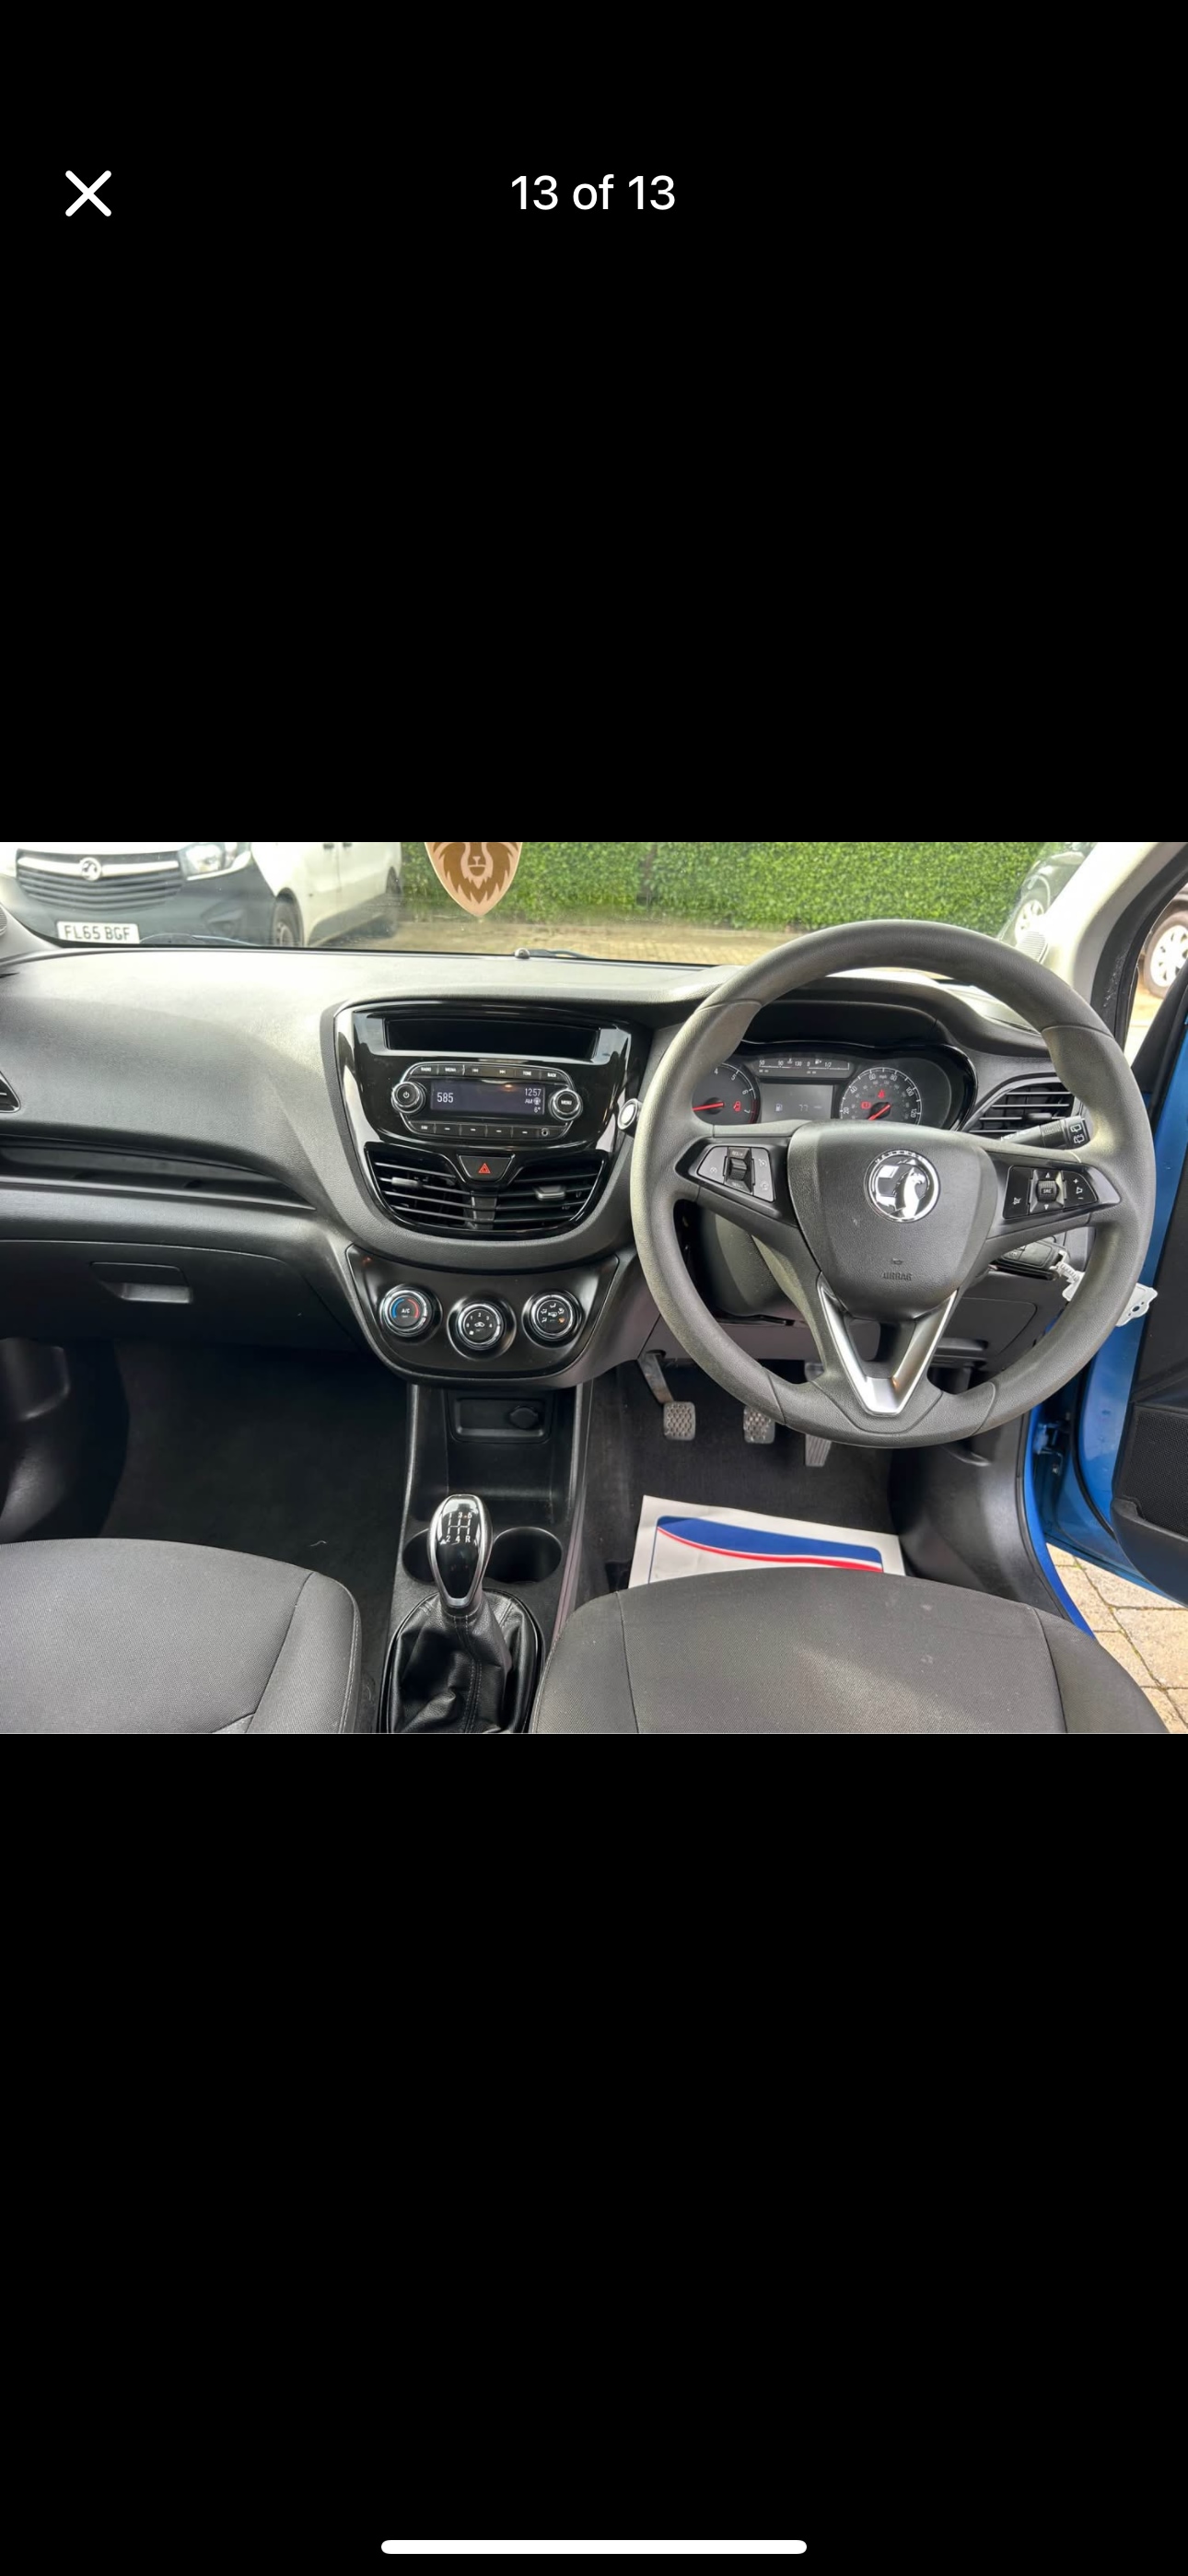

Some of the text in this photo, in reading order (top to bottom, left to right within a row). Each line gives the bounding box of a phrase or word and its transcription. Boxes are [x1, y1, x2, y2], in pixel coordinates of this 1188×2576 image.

[64, 925, 130, 941] FL65 BGF
[437, 1092, 454, 1103] 585
[882, 1271, 913, 1282] AIRBAG
[465, 1535, 471, 1543] R
